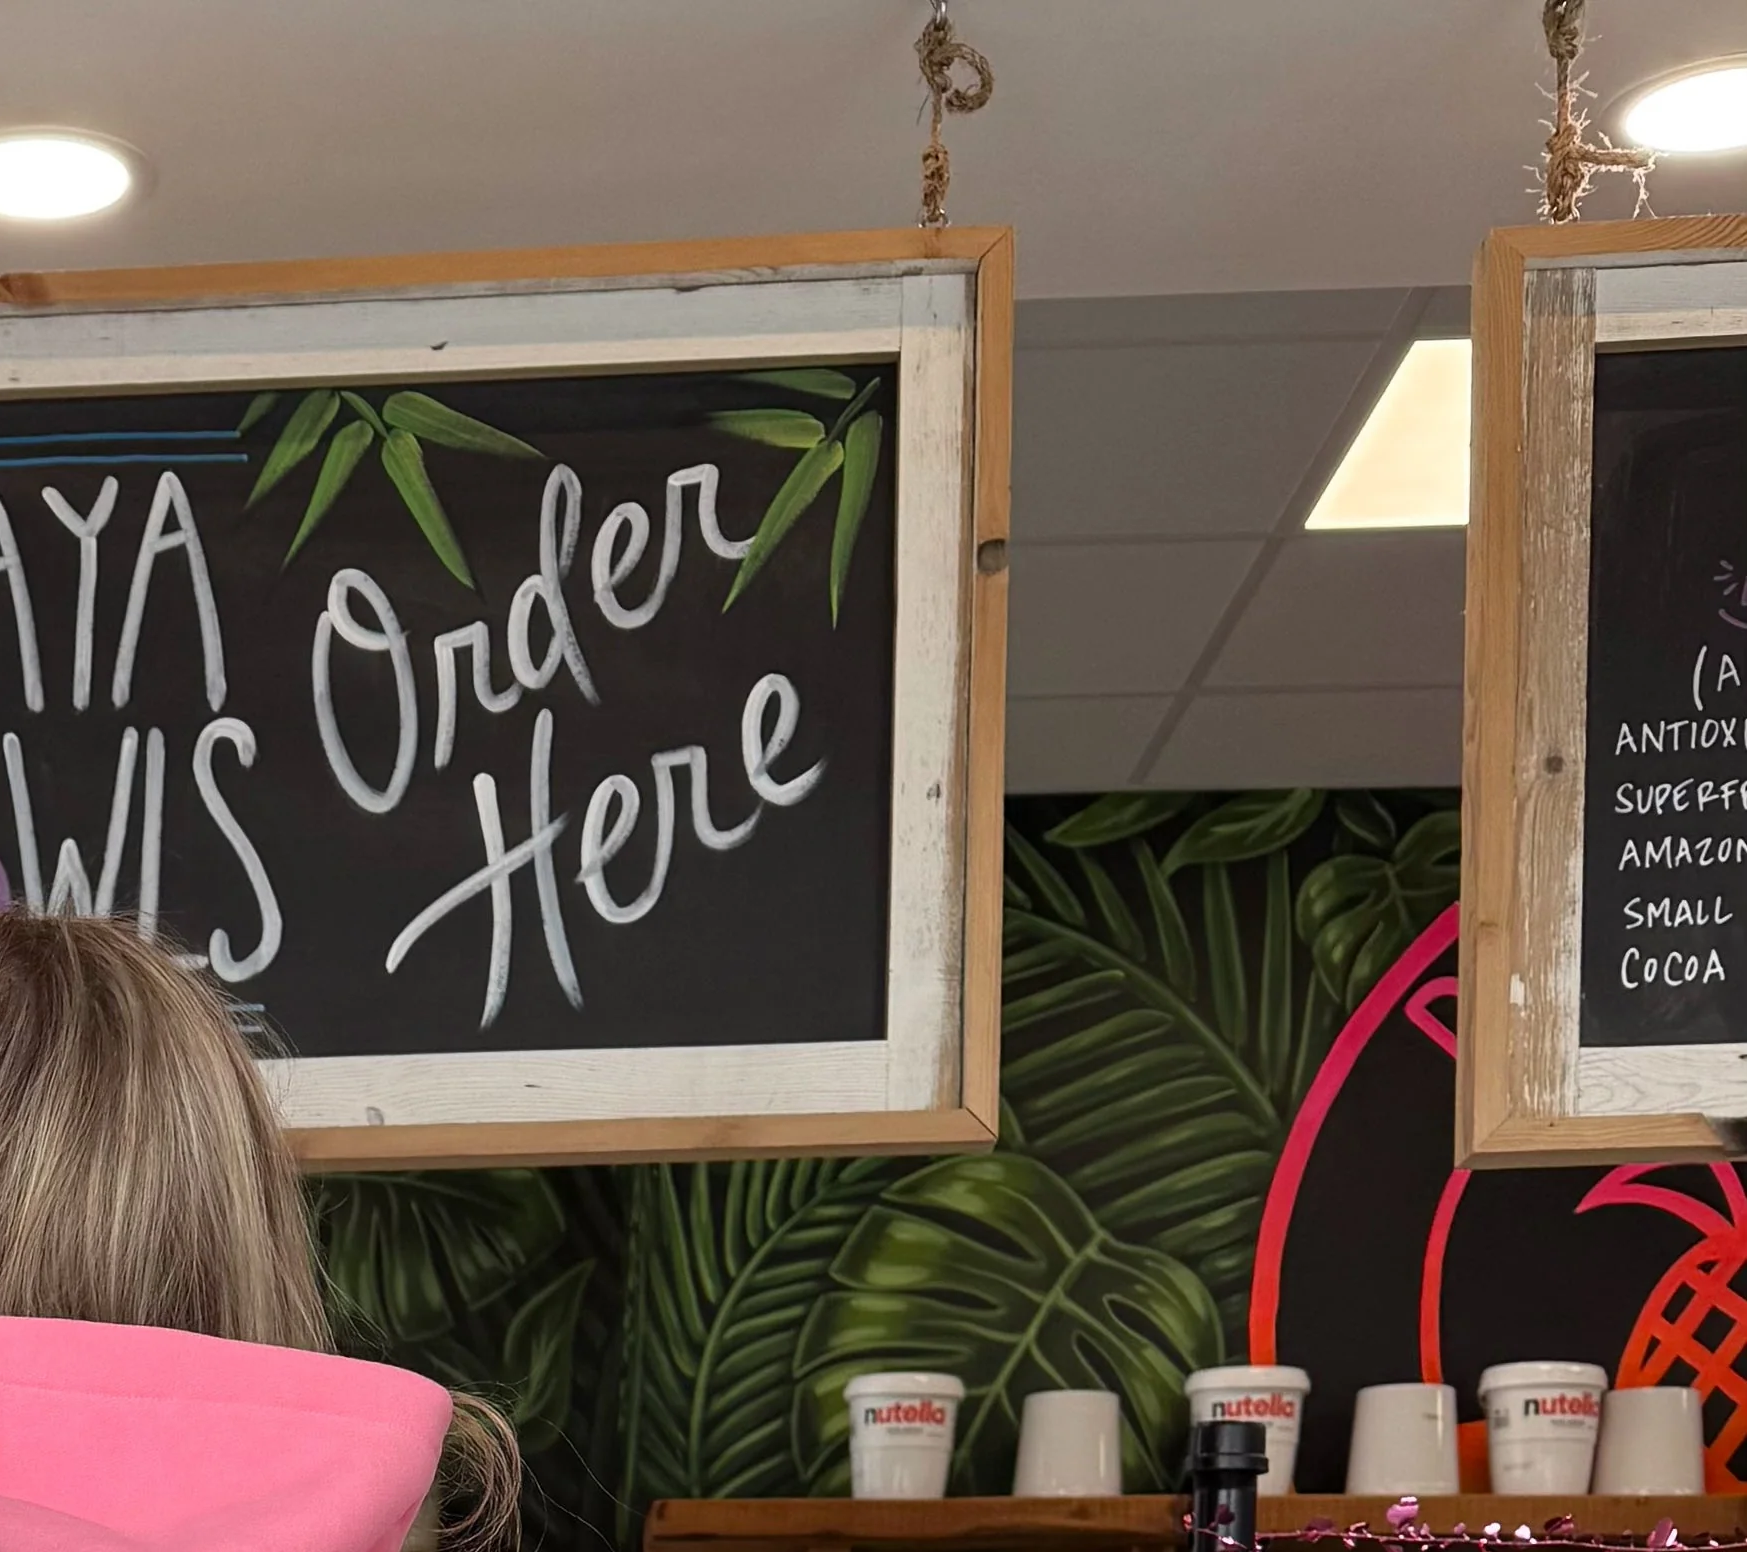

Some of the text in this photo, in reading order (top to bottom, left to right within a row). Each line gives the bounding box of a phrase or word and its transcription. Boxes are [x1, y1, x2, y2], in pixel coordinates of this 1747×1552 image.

[311, 463, 757, 814] Order
[1615, 717, 1747, 755] ANTIOX
[385, 673, 827, 1031] Here
[1623, 896, 1733, 929] SMALL
[1621, 947, 1725, 989] COCOA
[864, 1400, 946, 1425] nutella
[1212, 1392, 1295, 1418] nutella
